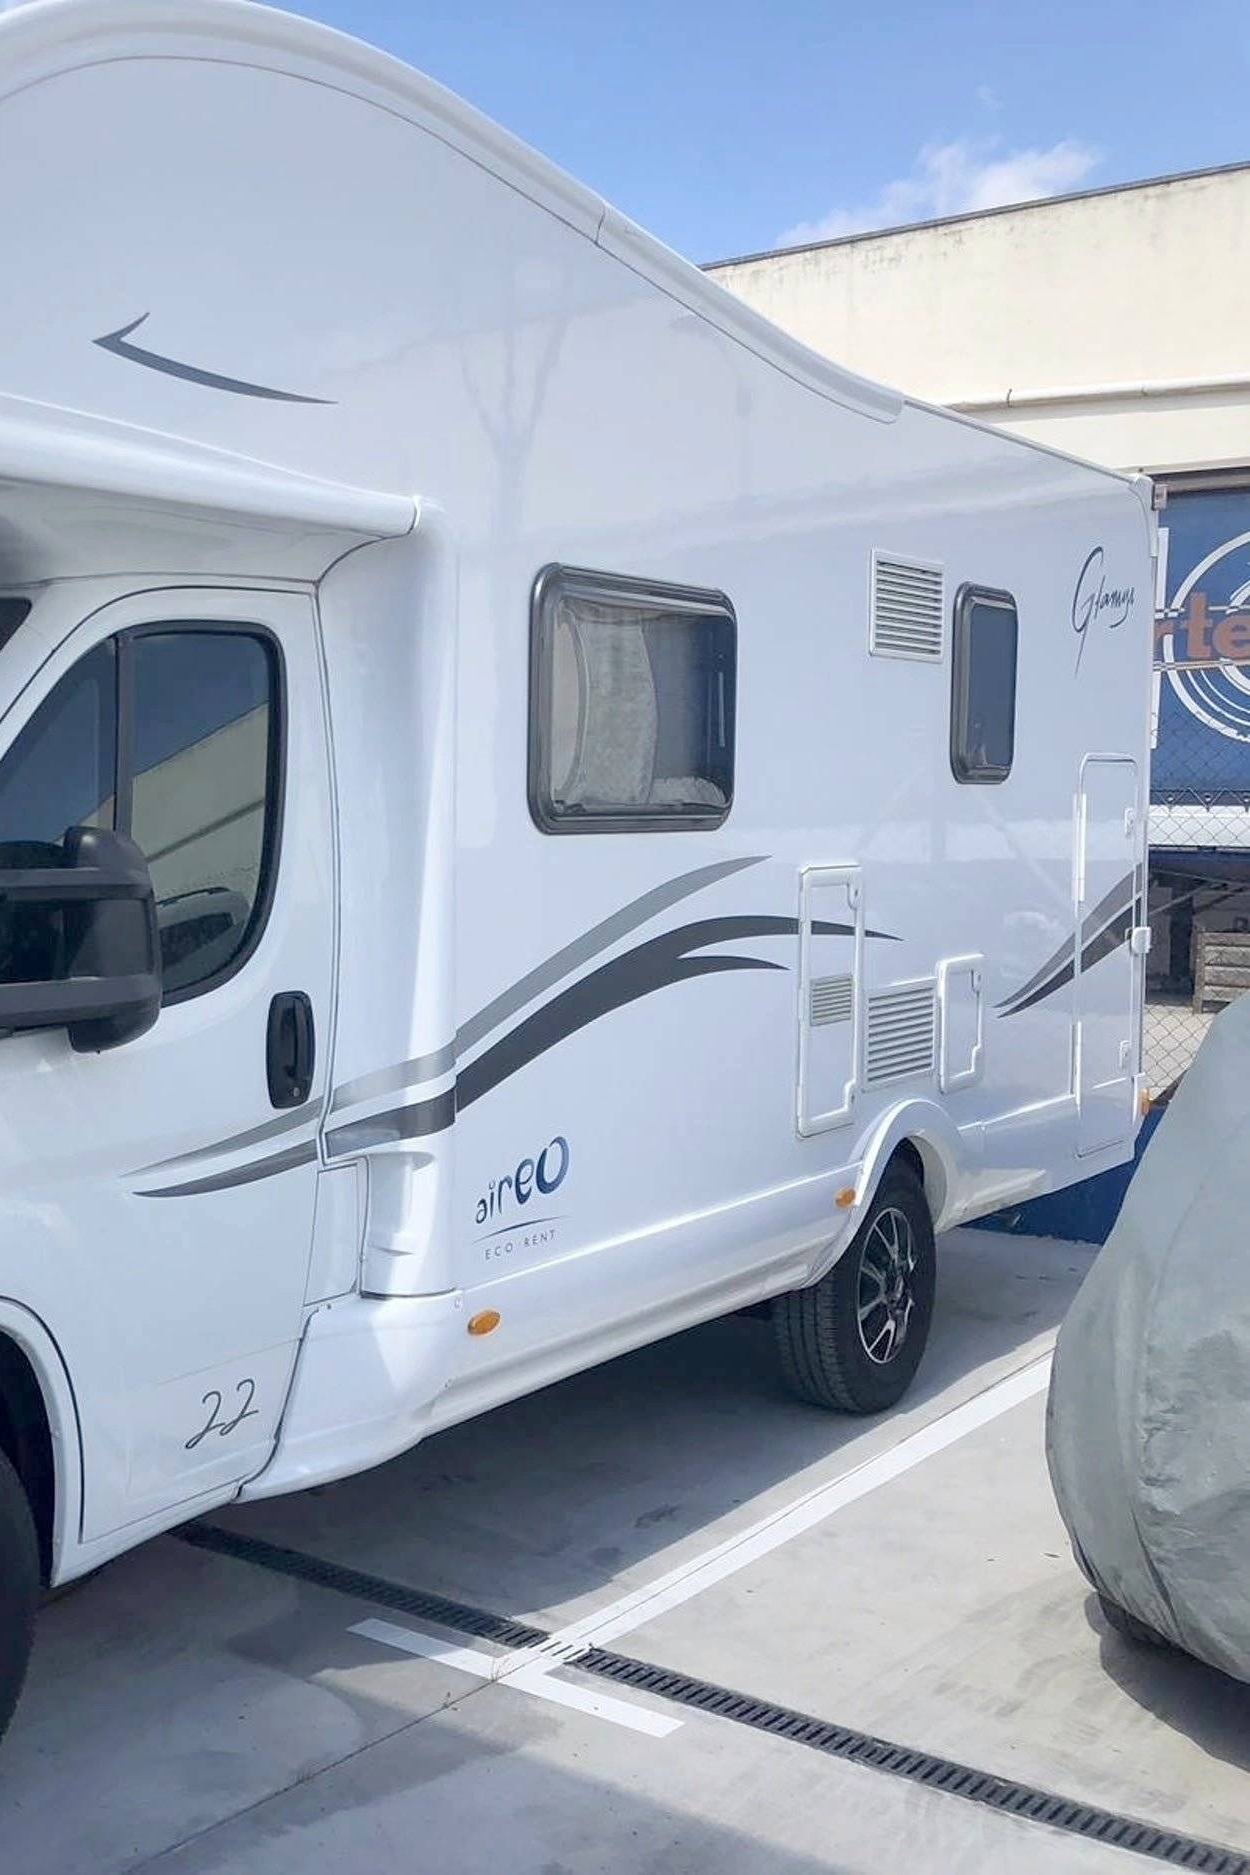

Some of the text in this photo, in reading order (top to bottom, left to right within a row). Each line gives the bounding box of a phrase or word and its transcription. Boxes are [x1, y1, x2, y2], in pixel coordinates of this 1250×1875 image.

[485, 1230, 558, 1261] ECO RENT
[184, 1378, 259, 1450] 22
